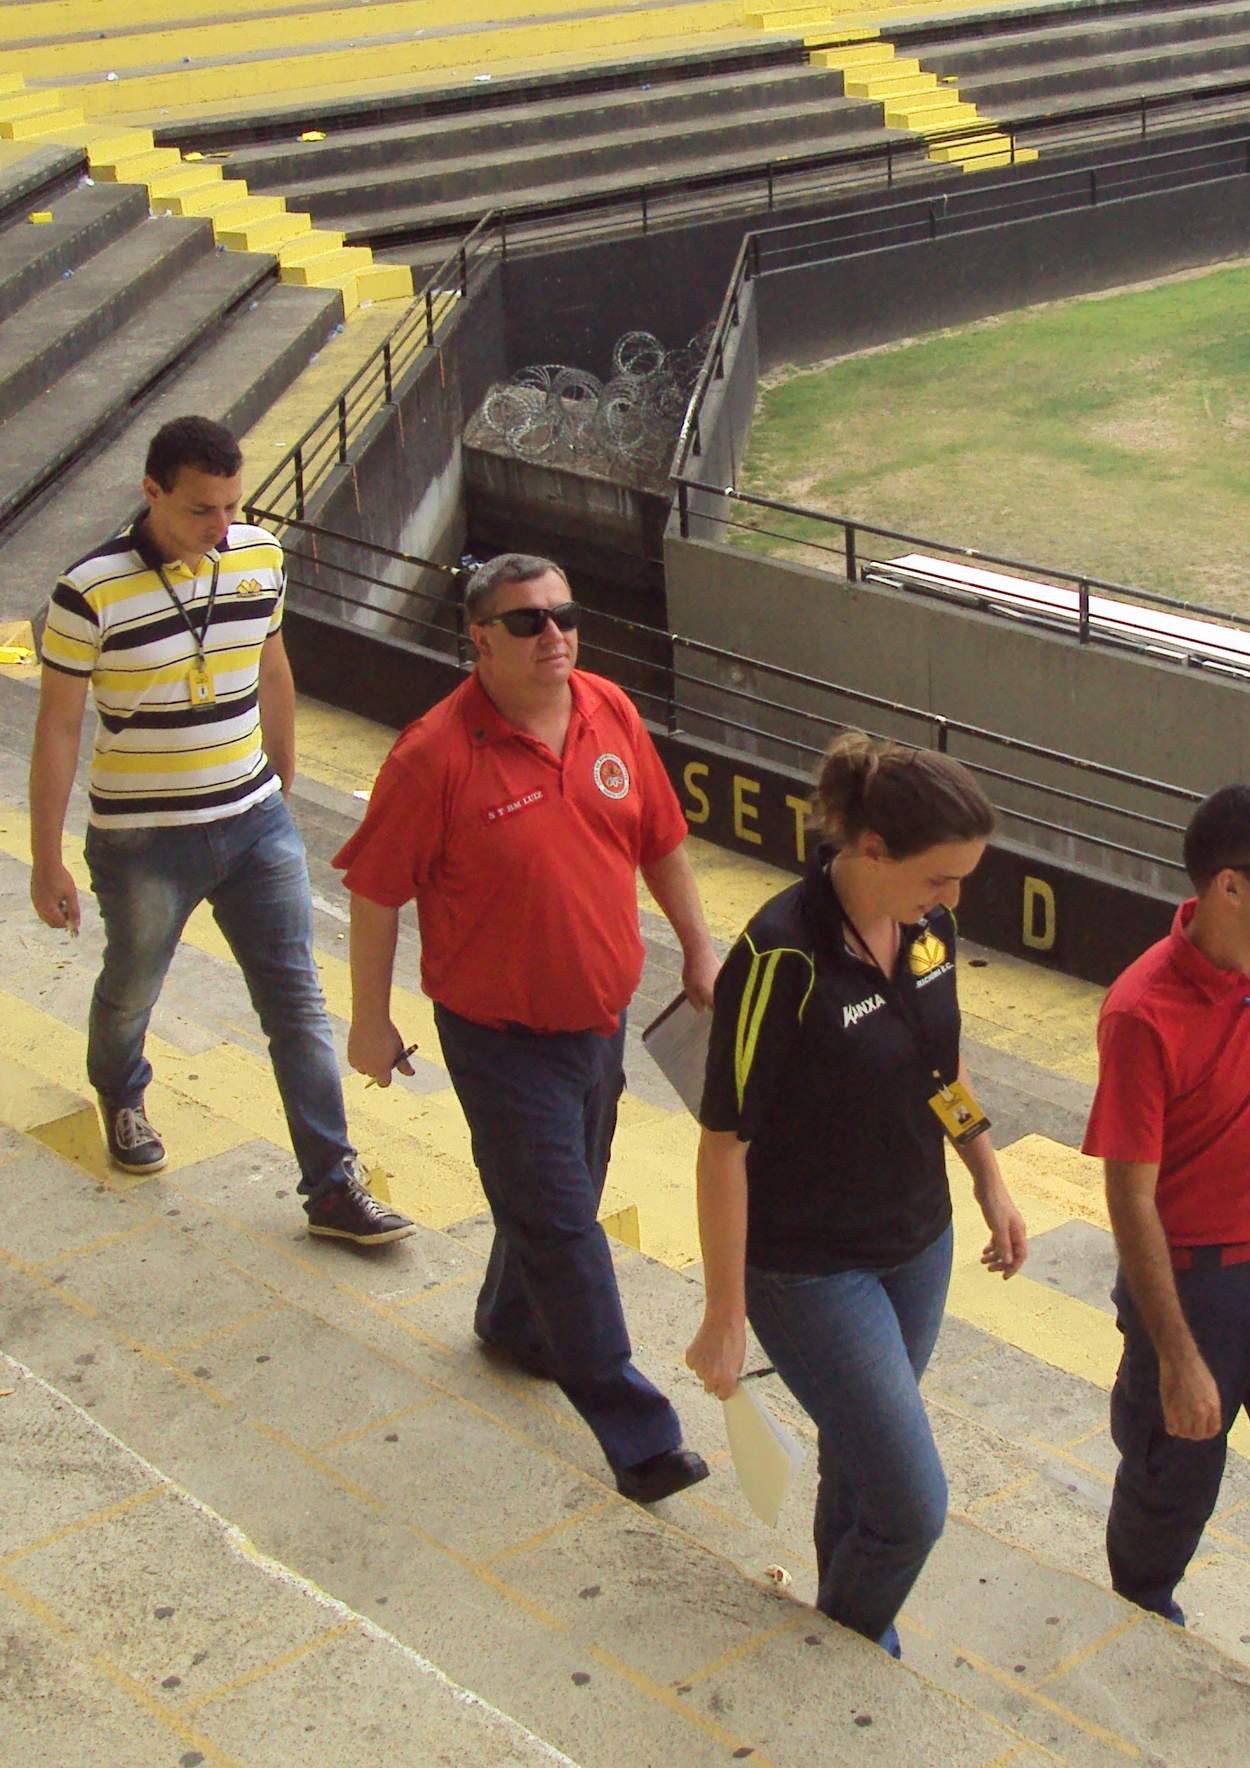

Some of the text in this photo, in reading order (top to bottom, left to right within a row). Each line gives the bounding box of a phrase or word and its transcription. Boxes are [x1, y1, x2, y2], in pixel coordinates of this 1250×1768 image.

[683, 761, 813, 862] SET
[1022, 875, 1056, 951] D
[842, 993, 887, 1028] KANXA
